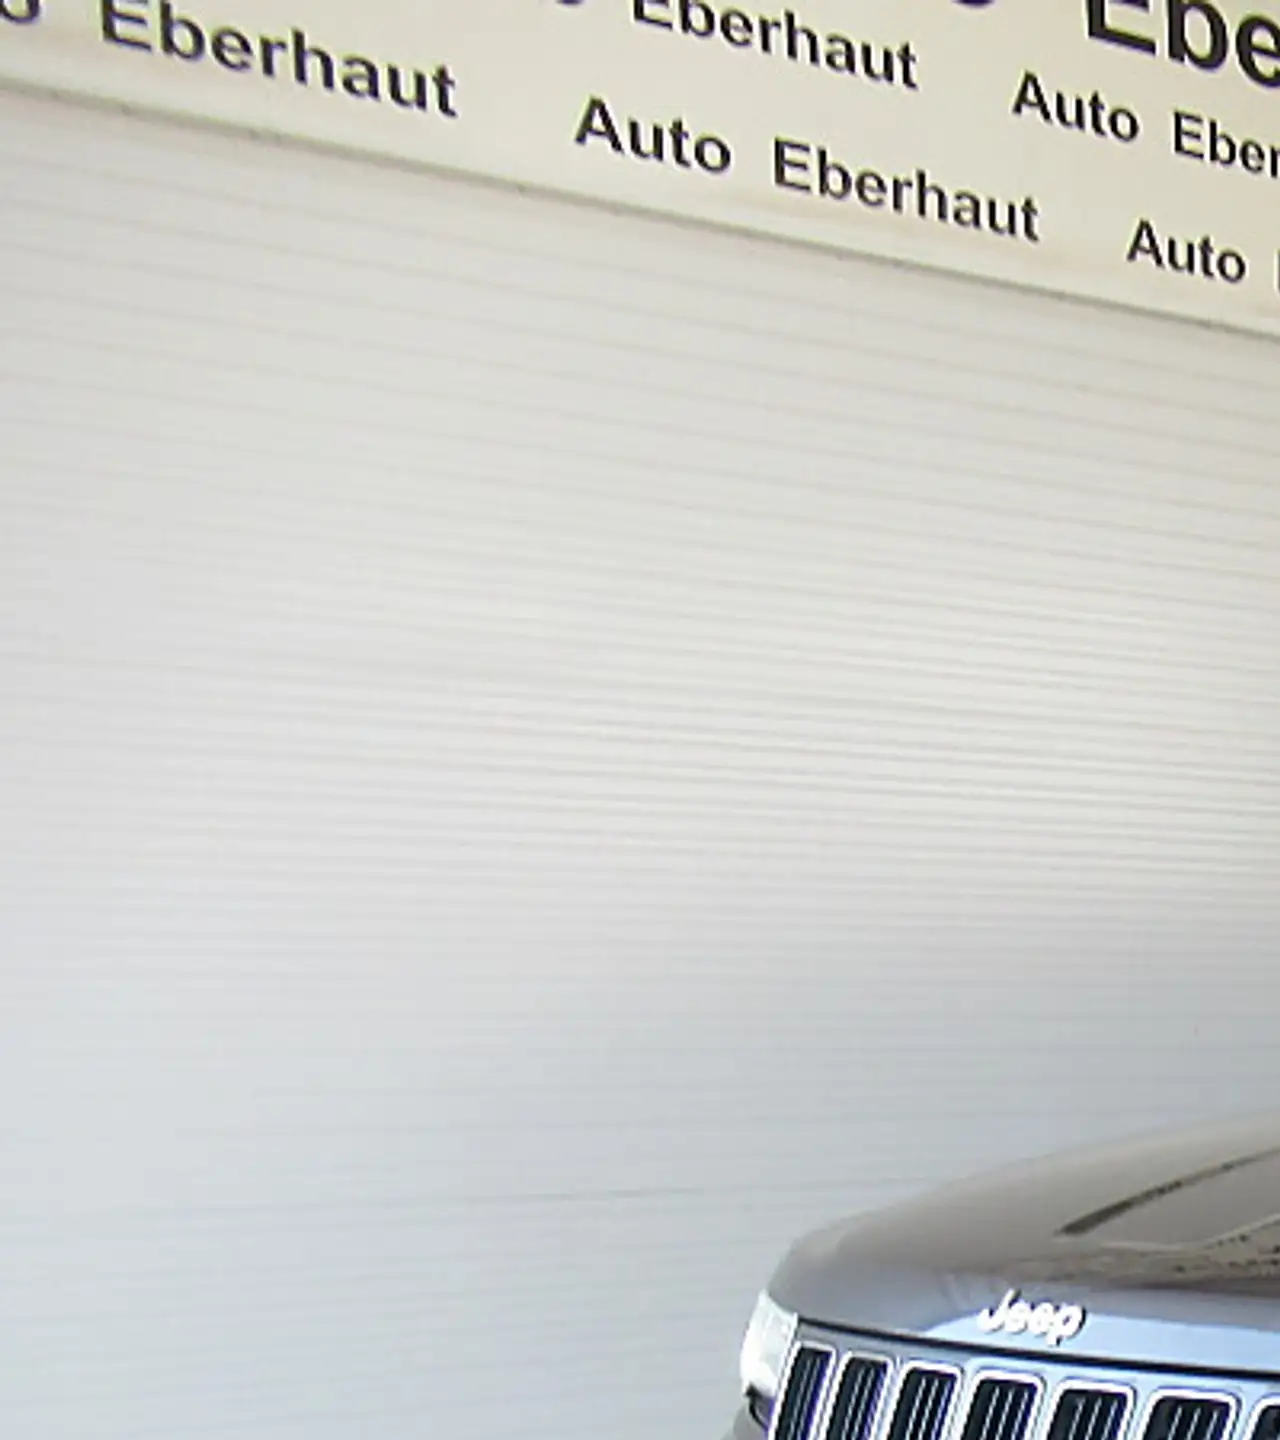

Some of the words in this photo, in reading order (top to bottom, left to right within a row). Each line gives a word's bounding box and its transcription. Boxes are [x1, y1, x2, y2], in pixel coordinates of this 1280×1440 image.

[100, 0, 458, 119] Eberhaut
[1010, 70, 1139, 142] Auto
[574, 97, 732, 175] Auto
[773, 136, 1040, 243] Eberhaut
[1127, 218, 1246, 284] Auto
[977, 1289, 1084, 1347] Jeep
